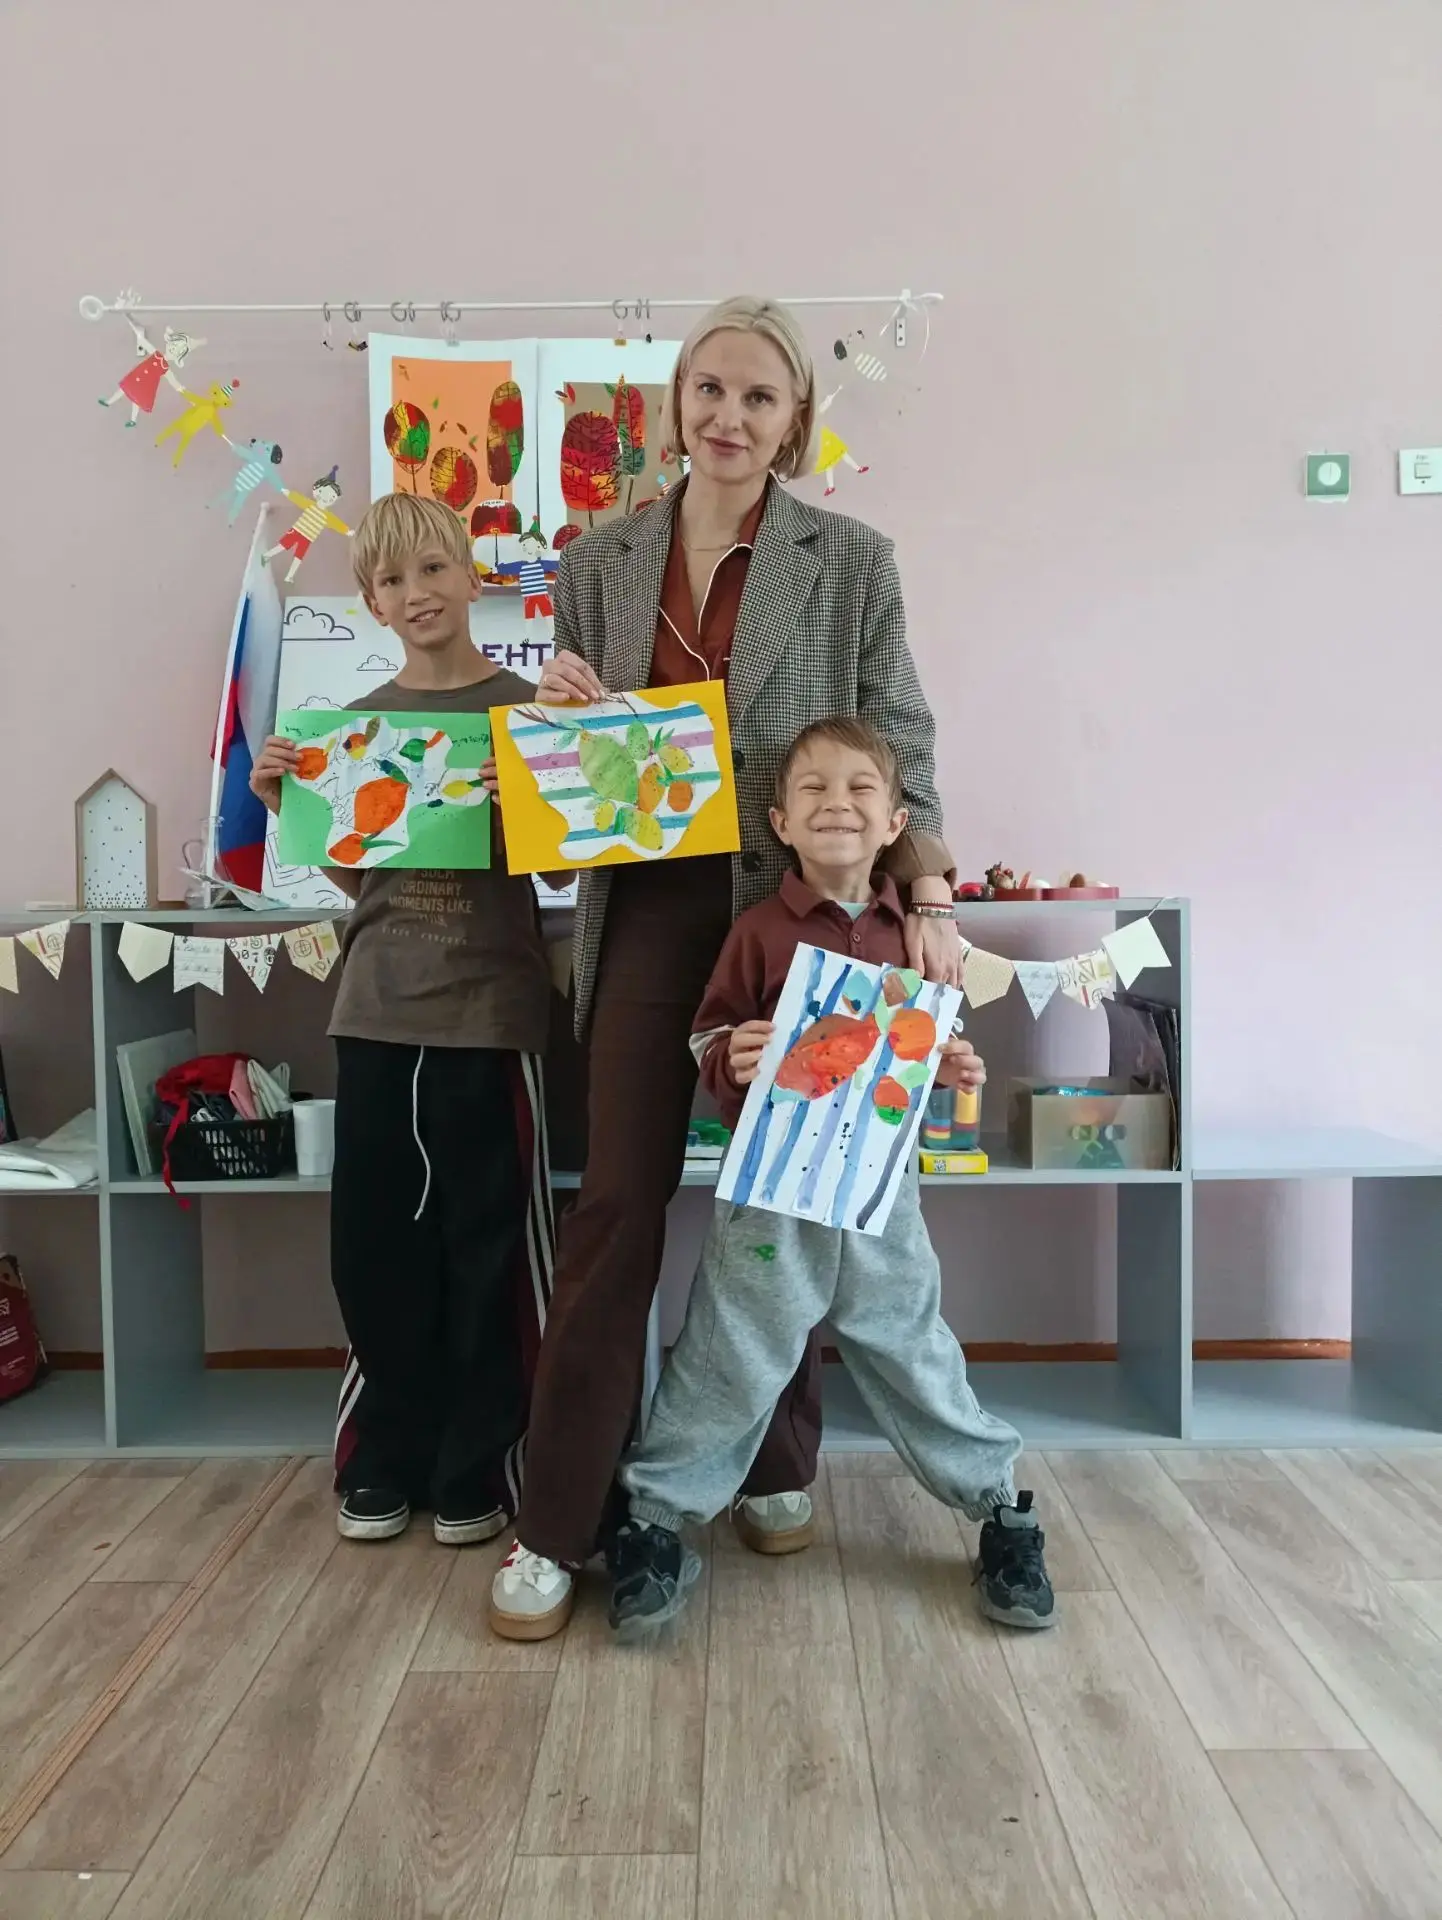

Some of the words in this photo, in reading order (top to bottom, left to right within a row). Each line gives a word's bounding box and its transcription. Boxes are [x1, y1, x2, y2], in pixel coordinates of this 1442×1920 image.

[401, 880, 463, 897] ORDINARY
[388, 893, 445, 912] MOMENTS
[446, 898, 474, 915] LIKE
